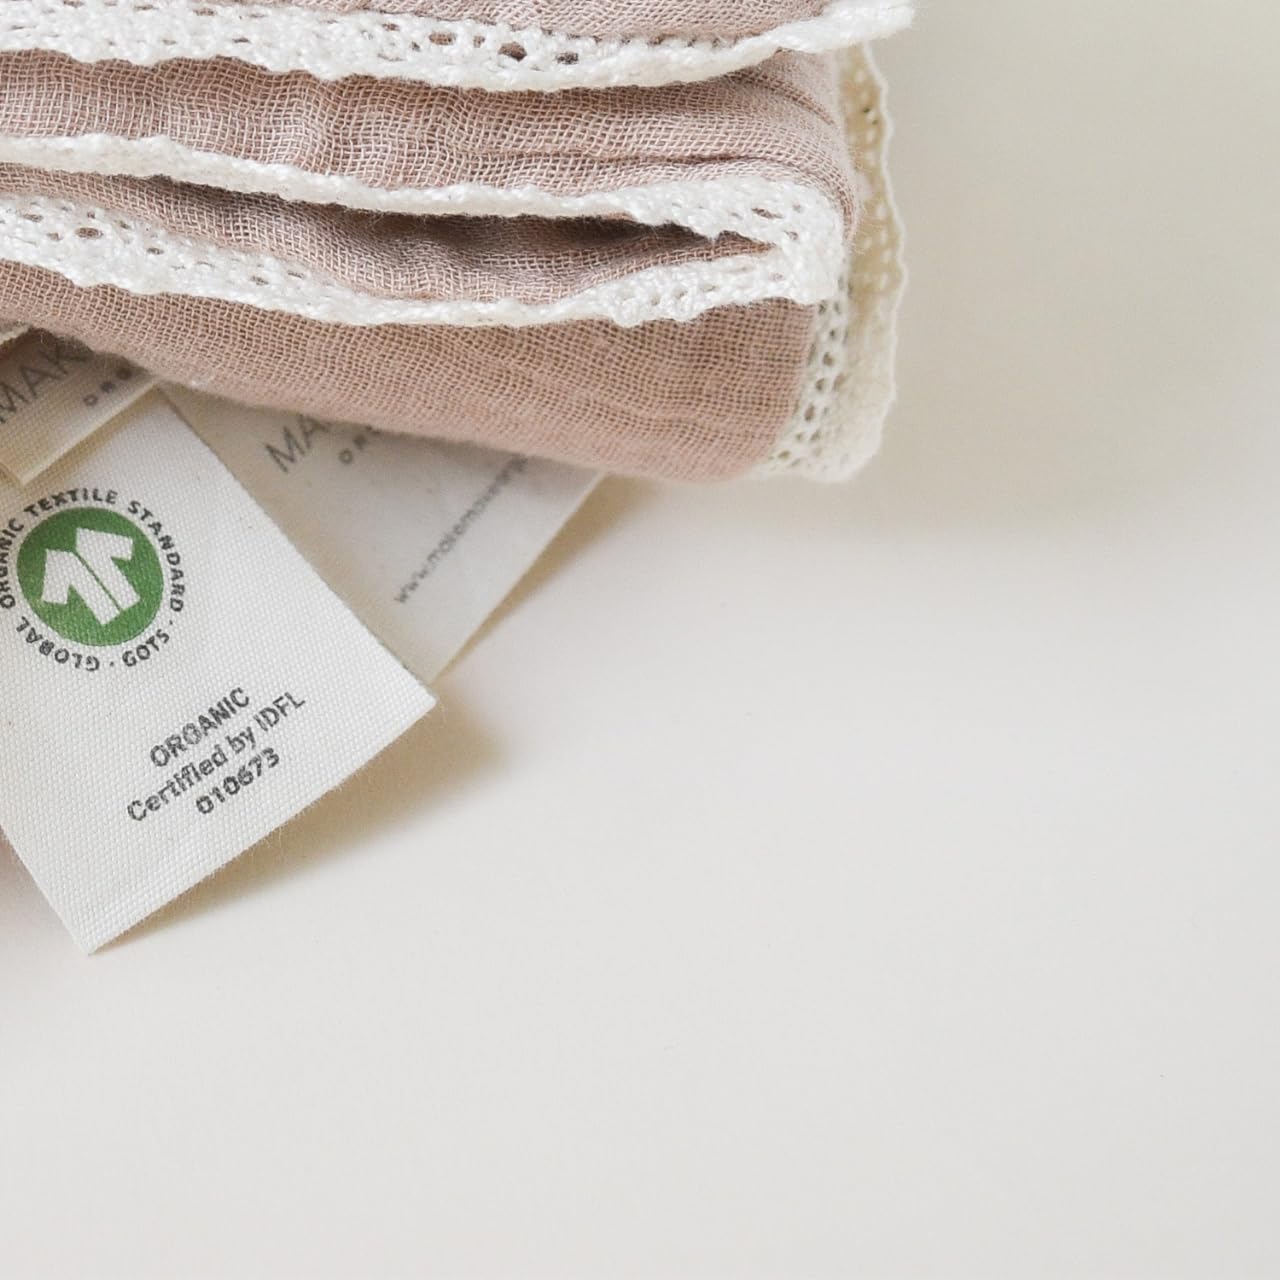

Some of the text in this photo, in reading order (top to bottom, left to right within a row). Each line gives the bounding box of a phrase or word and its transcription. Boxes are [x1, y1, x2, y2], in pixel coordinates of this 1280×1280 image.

[23, 488, 119, 517] TEXTILE
[127, 500, 186, 613] STANDARD
[15, 616, 101, 672] GLOBAL
[121, 628, 171, 668] GOTS
[127, 692, 307, 822] Certified by IDFL
[149, 687, 251, 768] ORGANIC
[195, 747, 281, 815] 010673
